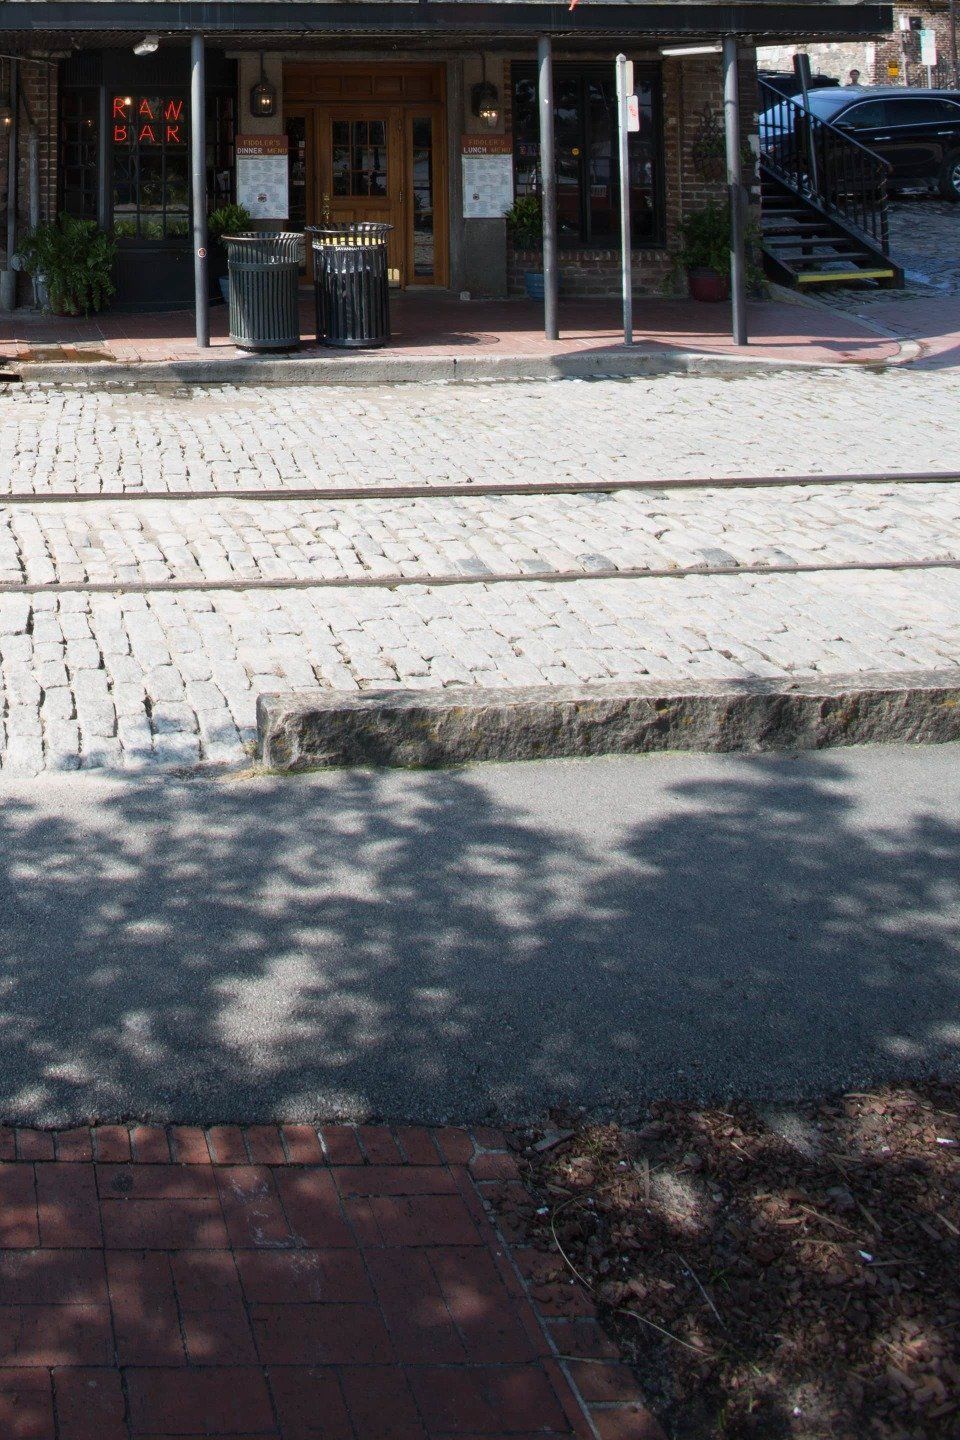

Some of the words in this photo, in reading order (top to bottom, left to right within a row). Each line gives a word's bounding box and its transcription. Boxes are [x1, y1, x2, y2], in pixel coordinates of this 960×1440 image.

[113, 97, 183, 120] RAW
[113, 124, 180, 143] BAR
[463, 146, 487, 154] LUNCH
